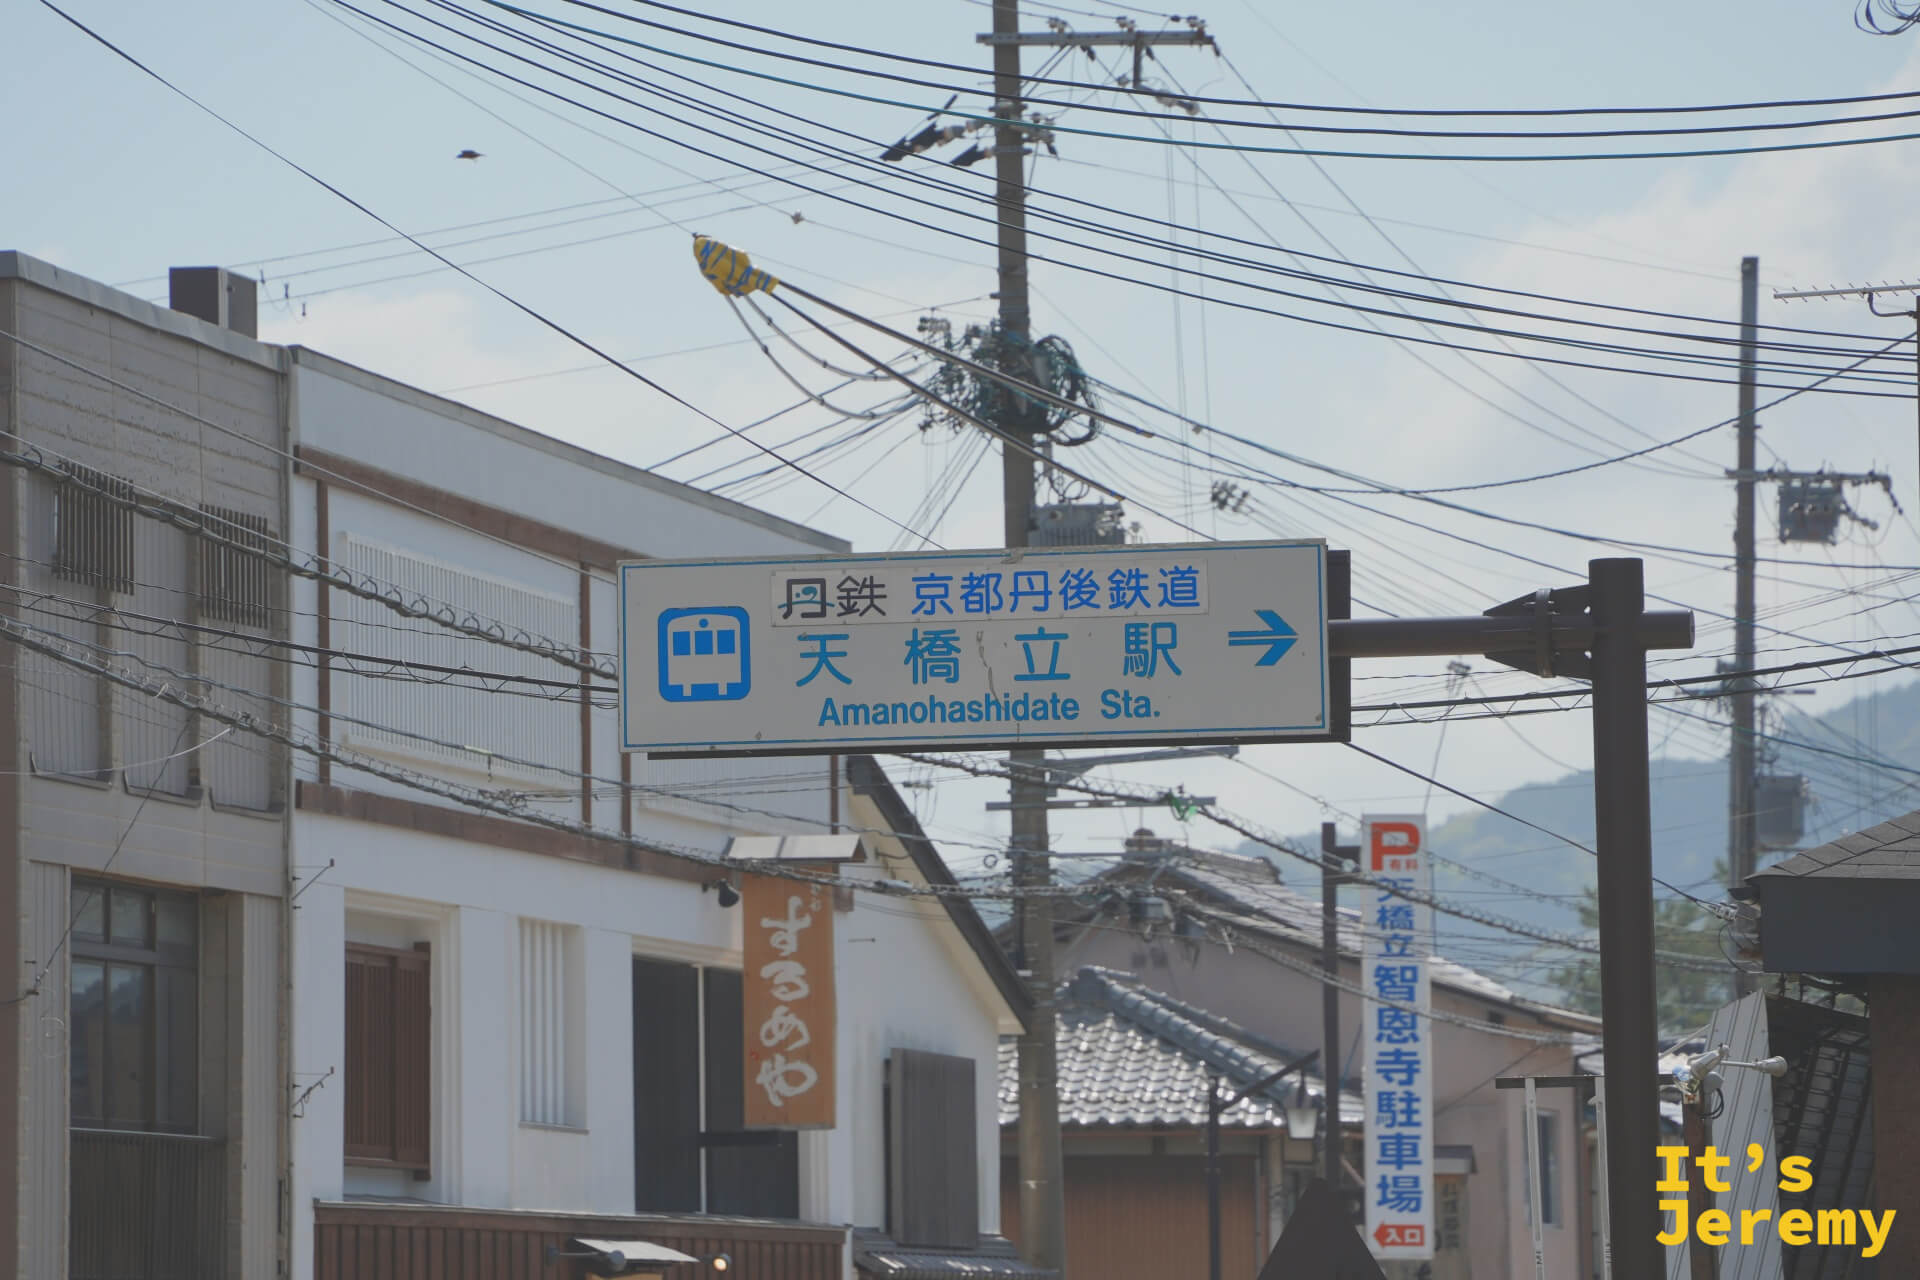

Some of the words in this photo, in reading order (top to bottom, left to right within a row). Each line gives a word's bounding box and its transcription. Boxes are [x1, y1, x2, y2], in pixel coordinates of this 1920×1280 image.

[910, 566, 1201, 615] 京都丹後鉄道
[796, 622, 1182, 687] 天橋立駅
[817, 694, 1081, 727] Amanohashidate
[1100, 689, 1161, 719] Sta.
[1370, 822, 1420, 871] P
[1385, 1227, 1421, 1243] 入口
